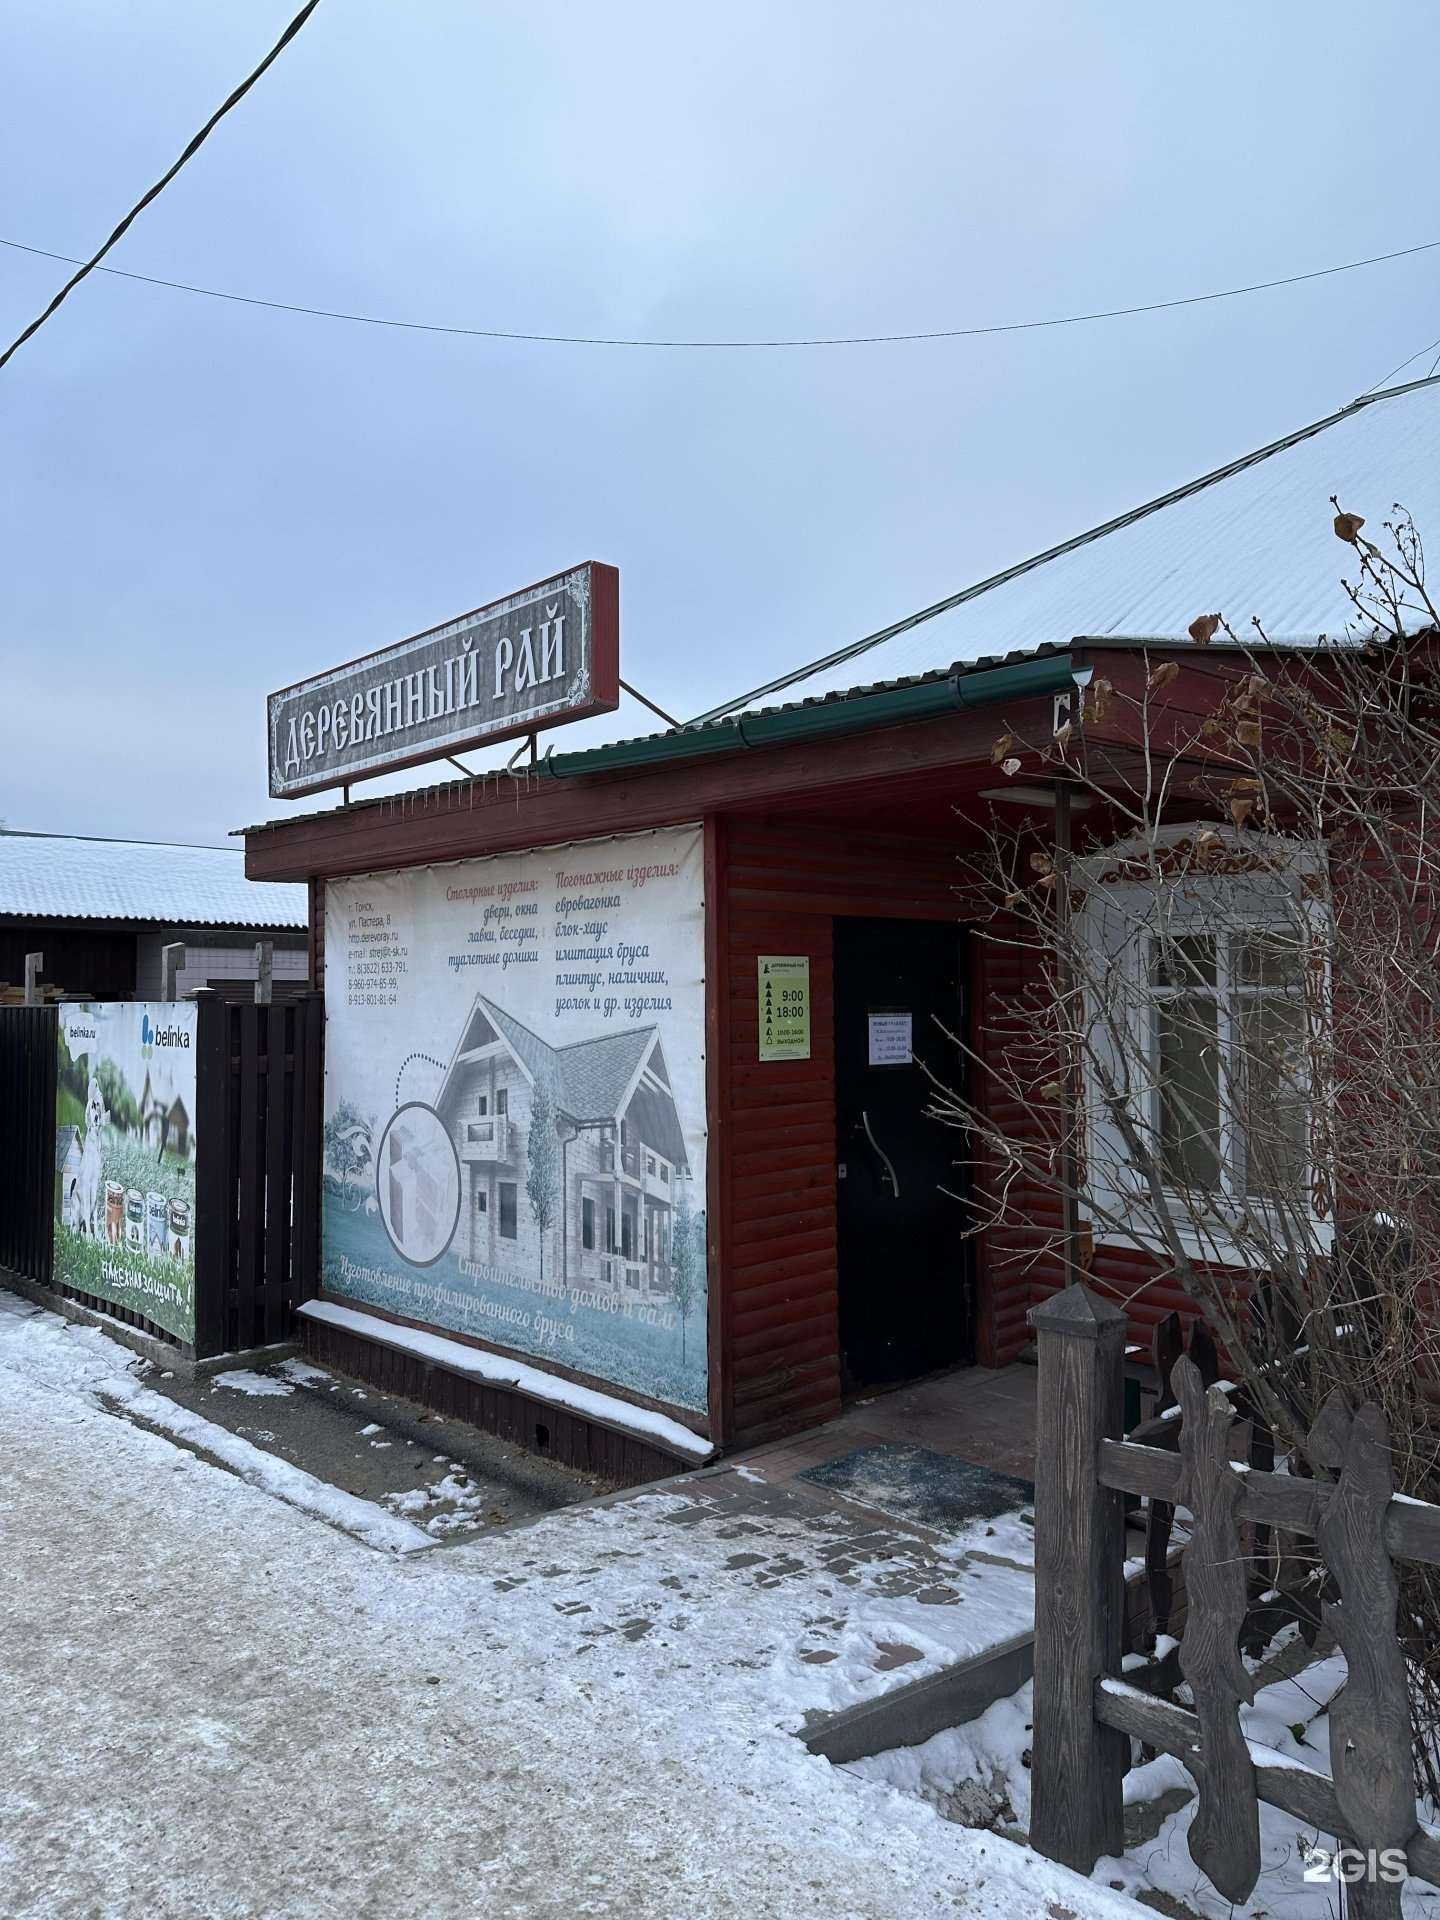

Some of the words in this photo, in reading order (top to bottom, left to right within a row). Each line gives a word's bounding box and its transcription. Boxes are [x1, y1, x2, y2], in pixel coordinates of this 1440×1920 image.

[284, 636, 480, 777] ДЕРЕВЯННЫЙ
[493, 602, 566, 700] РАЙ
[555, 870, 624, 889] Погонажные
[626, 863, 680, 888] изделия:
[446, 884, 495, 905] Столярные
[497, 879, 539, 902] изделия:
[483, 905, 512, 926] двери,
[515, 903, 538, 915] окна
[555, 894, 621, 919] евровагонка
[467, 931, 497, 945] лавки,
[499, 927, 539, 946] беседки,
[555, 920, 608, 942] блок-хаус
[448, 952, 500, 973] туалетные
[503, 950, 539, 970] домики
[555, 947, 614, 965] имитация
[616, 942, 650, 967] бруса
[555, 973, 605, 992] плинтус,
[608, 970, 669, 986] наличник,
[555, 998, 591, 1016] уголок
[594, 998, 601, 1010] и
[603, 998, 620, 1017] др.
[623, 996, 672, 1016] изделия
[782, 990, 804, 1002] 9:00
[776, 1006, 804, 1018] 18:00
[70, 1026, 96, 1039] belinka.ru
[155, 1025, 190, 1048] belinka
[458, 1255, 568, 1302] Строительство
[570, 1285, 619, 1315] домов
[340, 1256, 412, 1298] Изготовление
[413, 1280, 531, 1327] профилированного
[534, 1309, 575, 1347] бруса
